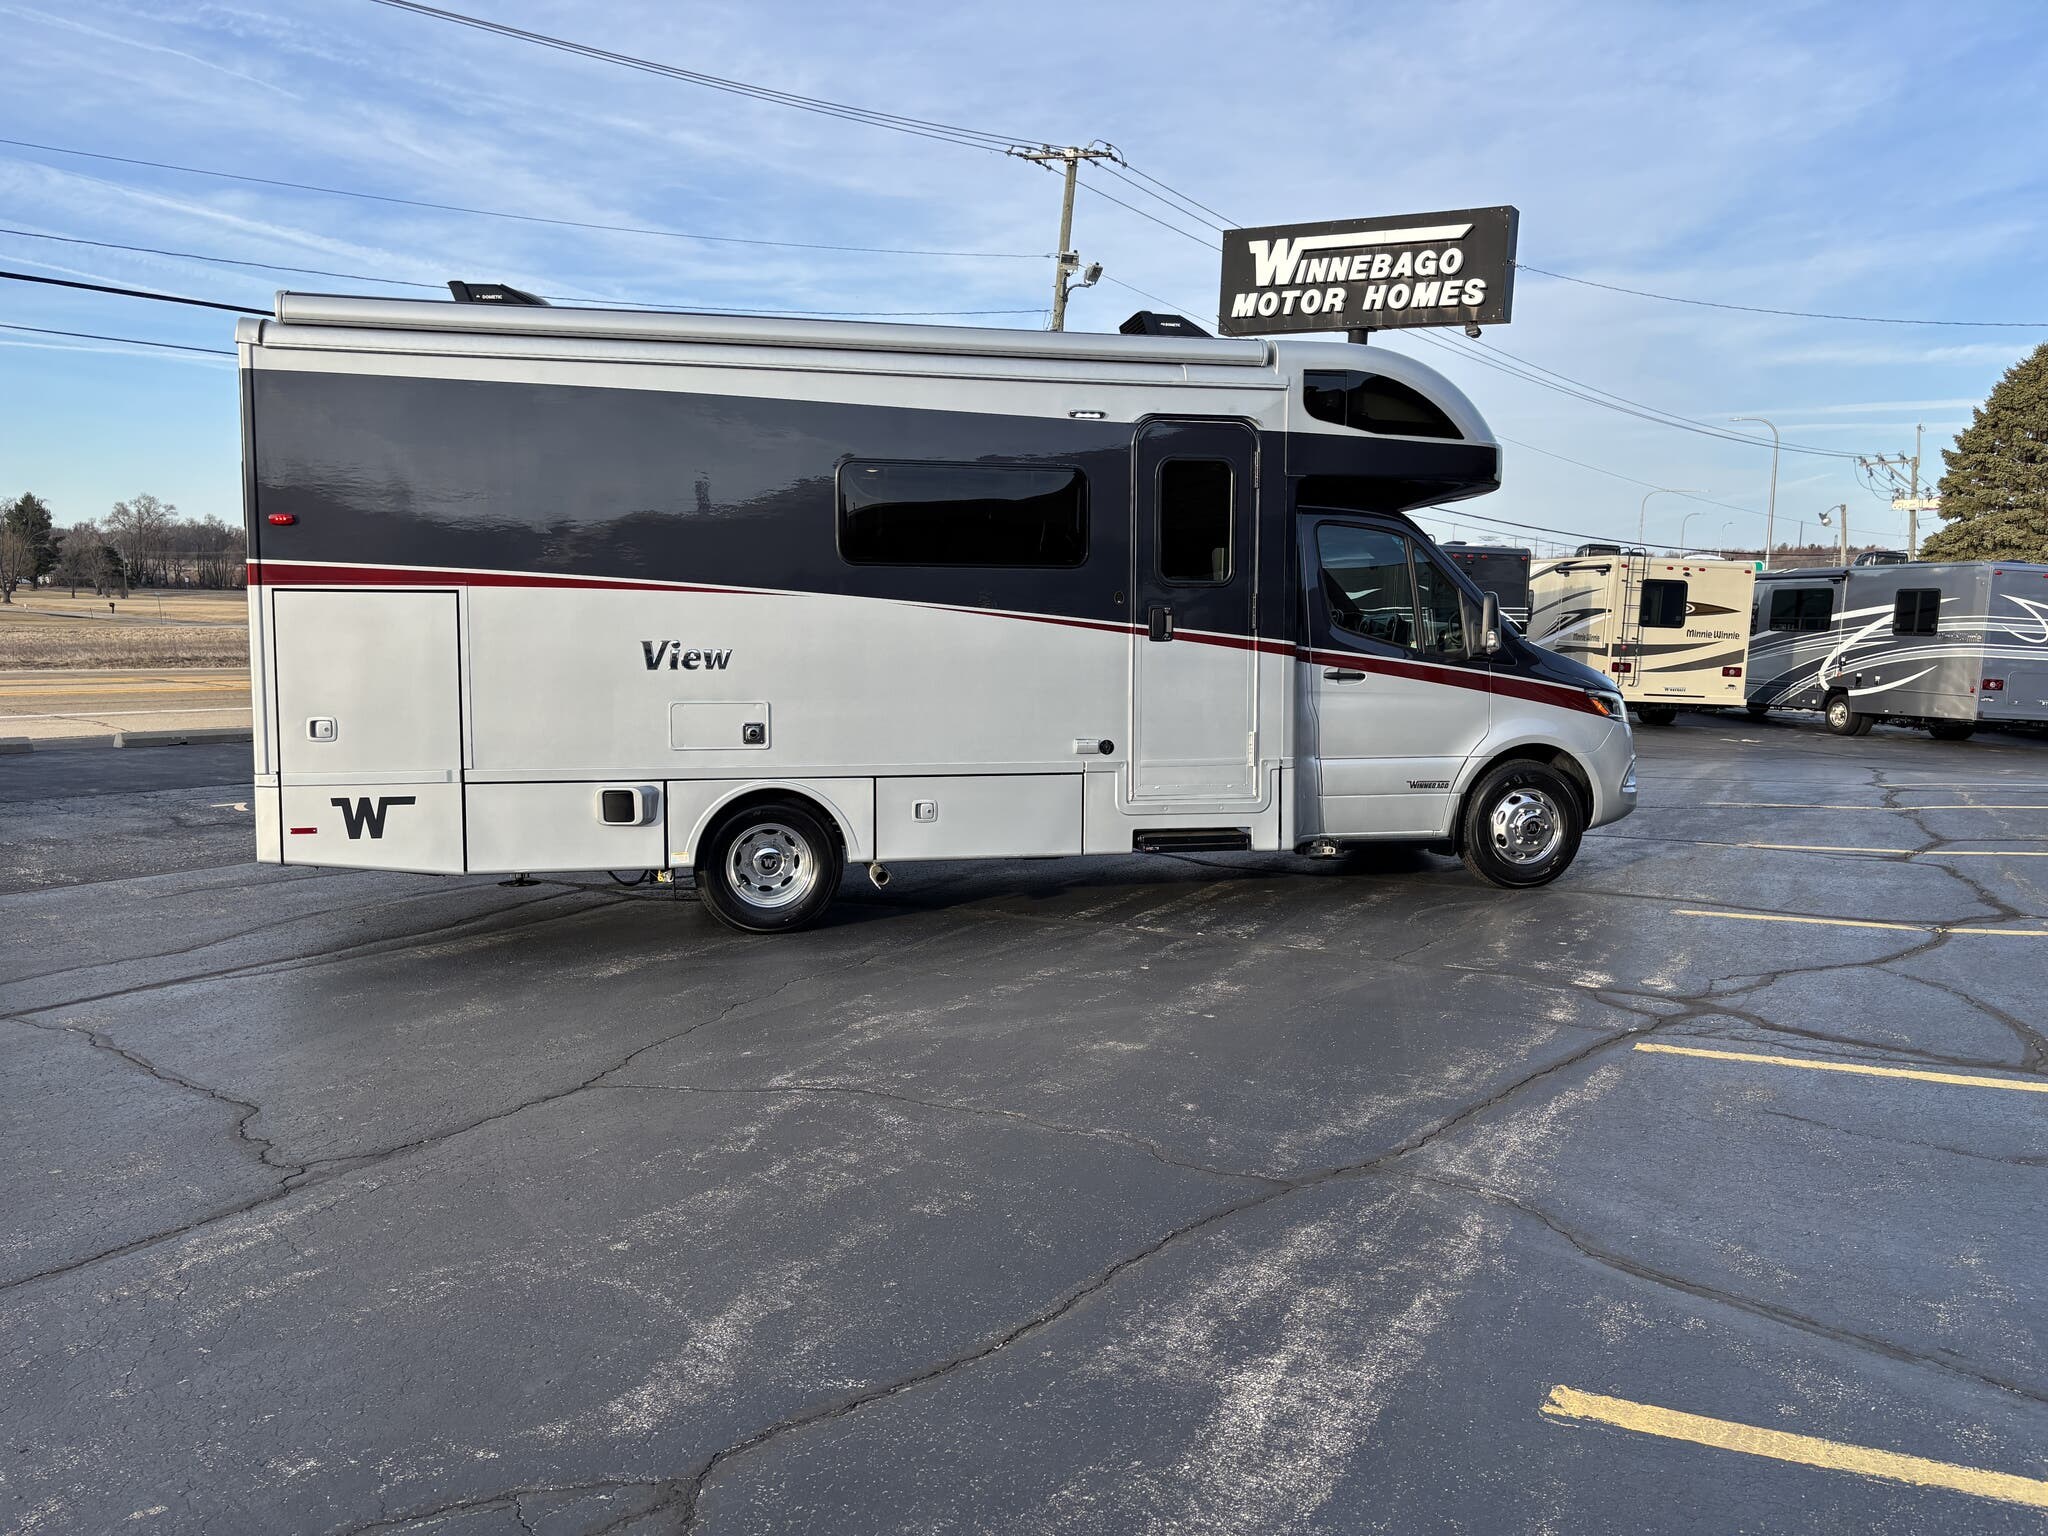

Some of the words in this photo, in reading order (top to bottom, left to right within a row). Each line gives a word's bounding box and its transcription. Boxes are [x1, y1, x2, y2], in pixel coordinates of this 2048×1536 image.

[1248, 223, 1475, 287] WINNEBAGO
[1231, 287, 1348, 318] MOTOR
[1362, 278, 1488, 312] HOMES
[1686, 629, 1713, 639] Minnie
[1713, 630, 1740, 640] Winnie
[640, 639, 733, 671] View
[330, 796, 417, 840] W
